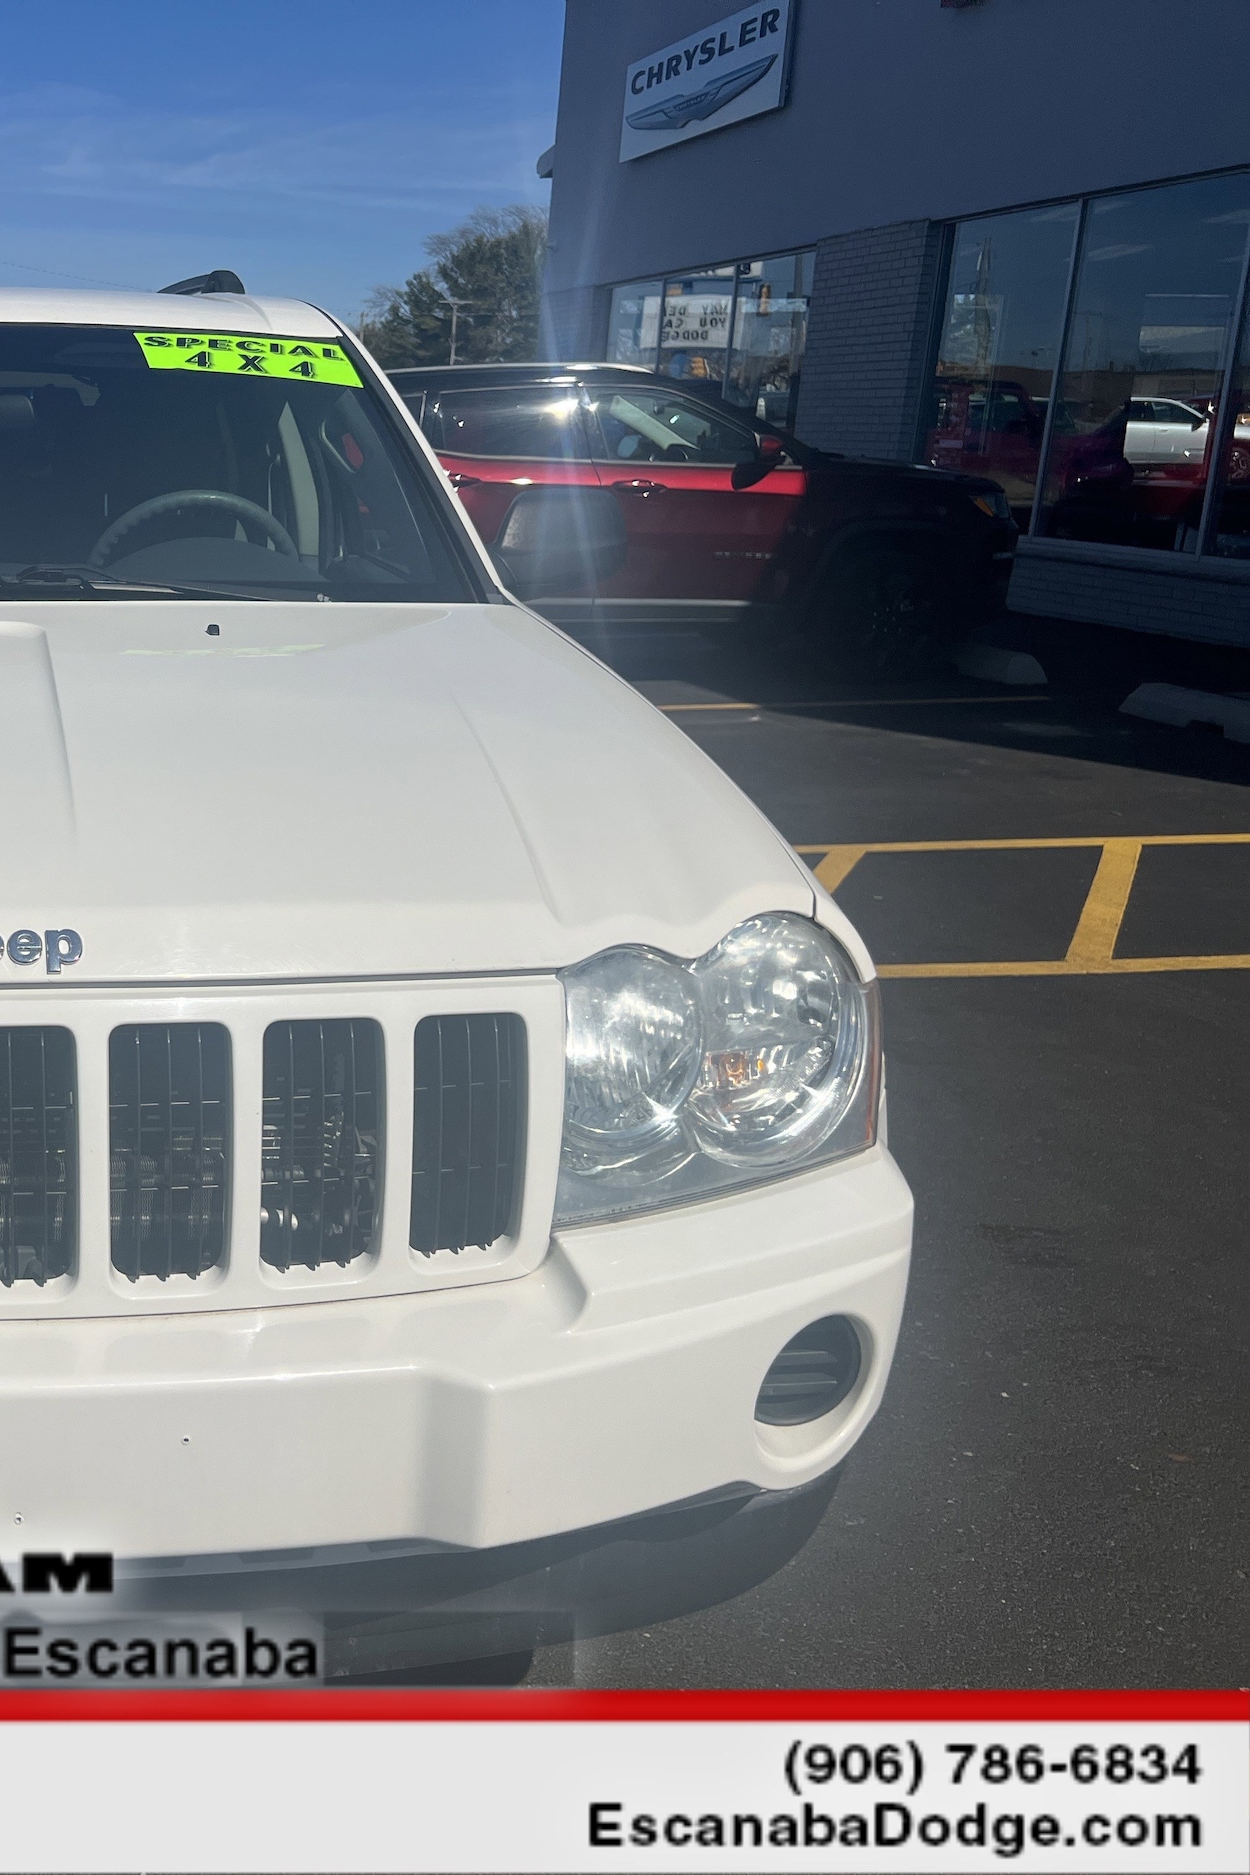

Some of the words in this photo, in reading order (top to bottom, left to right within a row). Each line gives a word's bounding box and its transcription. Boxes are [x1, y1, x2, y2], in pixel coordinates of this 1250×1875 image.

[631, 8, 780, 95] CHRYSLER
[143, 336, 347, 361] SPECIAL
[185, 351, 211, 369] 4
[289, 361, 315, 379] 4
